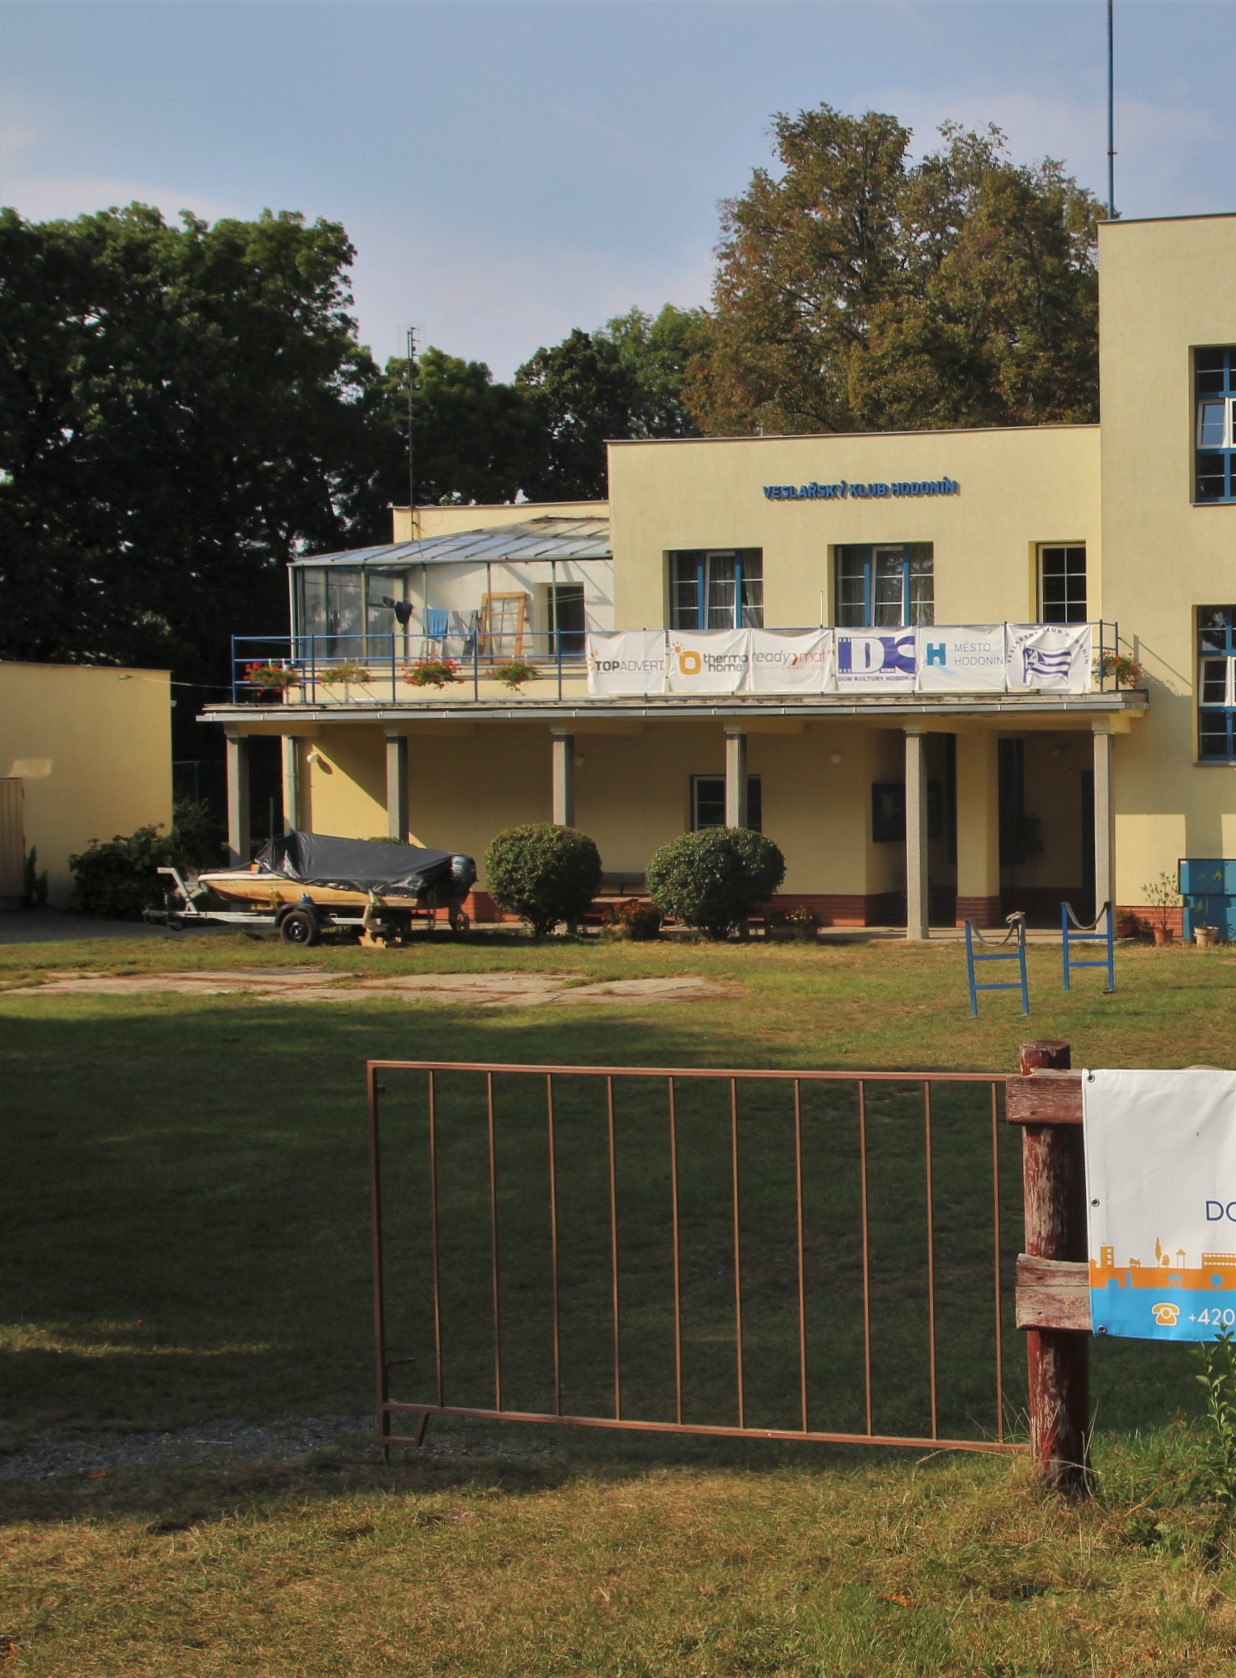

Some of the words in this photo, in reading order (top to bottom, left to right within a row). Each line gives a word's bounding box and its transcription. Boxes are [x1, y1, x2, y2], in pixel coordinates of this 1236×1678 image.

[762, 480, 847, 499] VESLAŘSKÝ
[848, 483, 887, 498] KLUB
[890, 476, 958, 496] HODONÍN
[954, 641, 992, 653] MĚSTO
[703, 653, 749, 664] thermo
[752, 650, 790, 666] ready
[954, 654, 1004, 666] HODONÍN
[708, 663, 743, 672] home
[1188, 1308, 1236, 1326] +420
